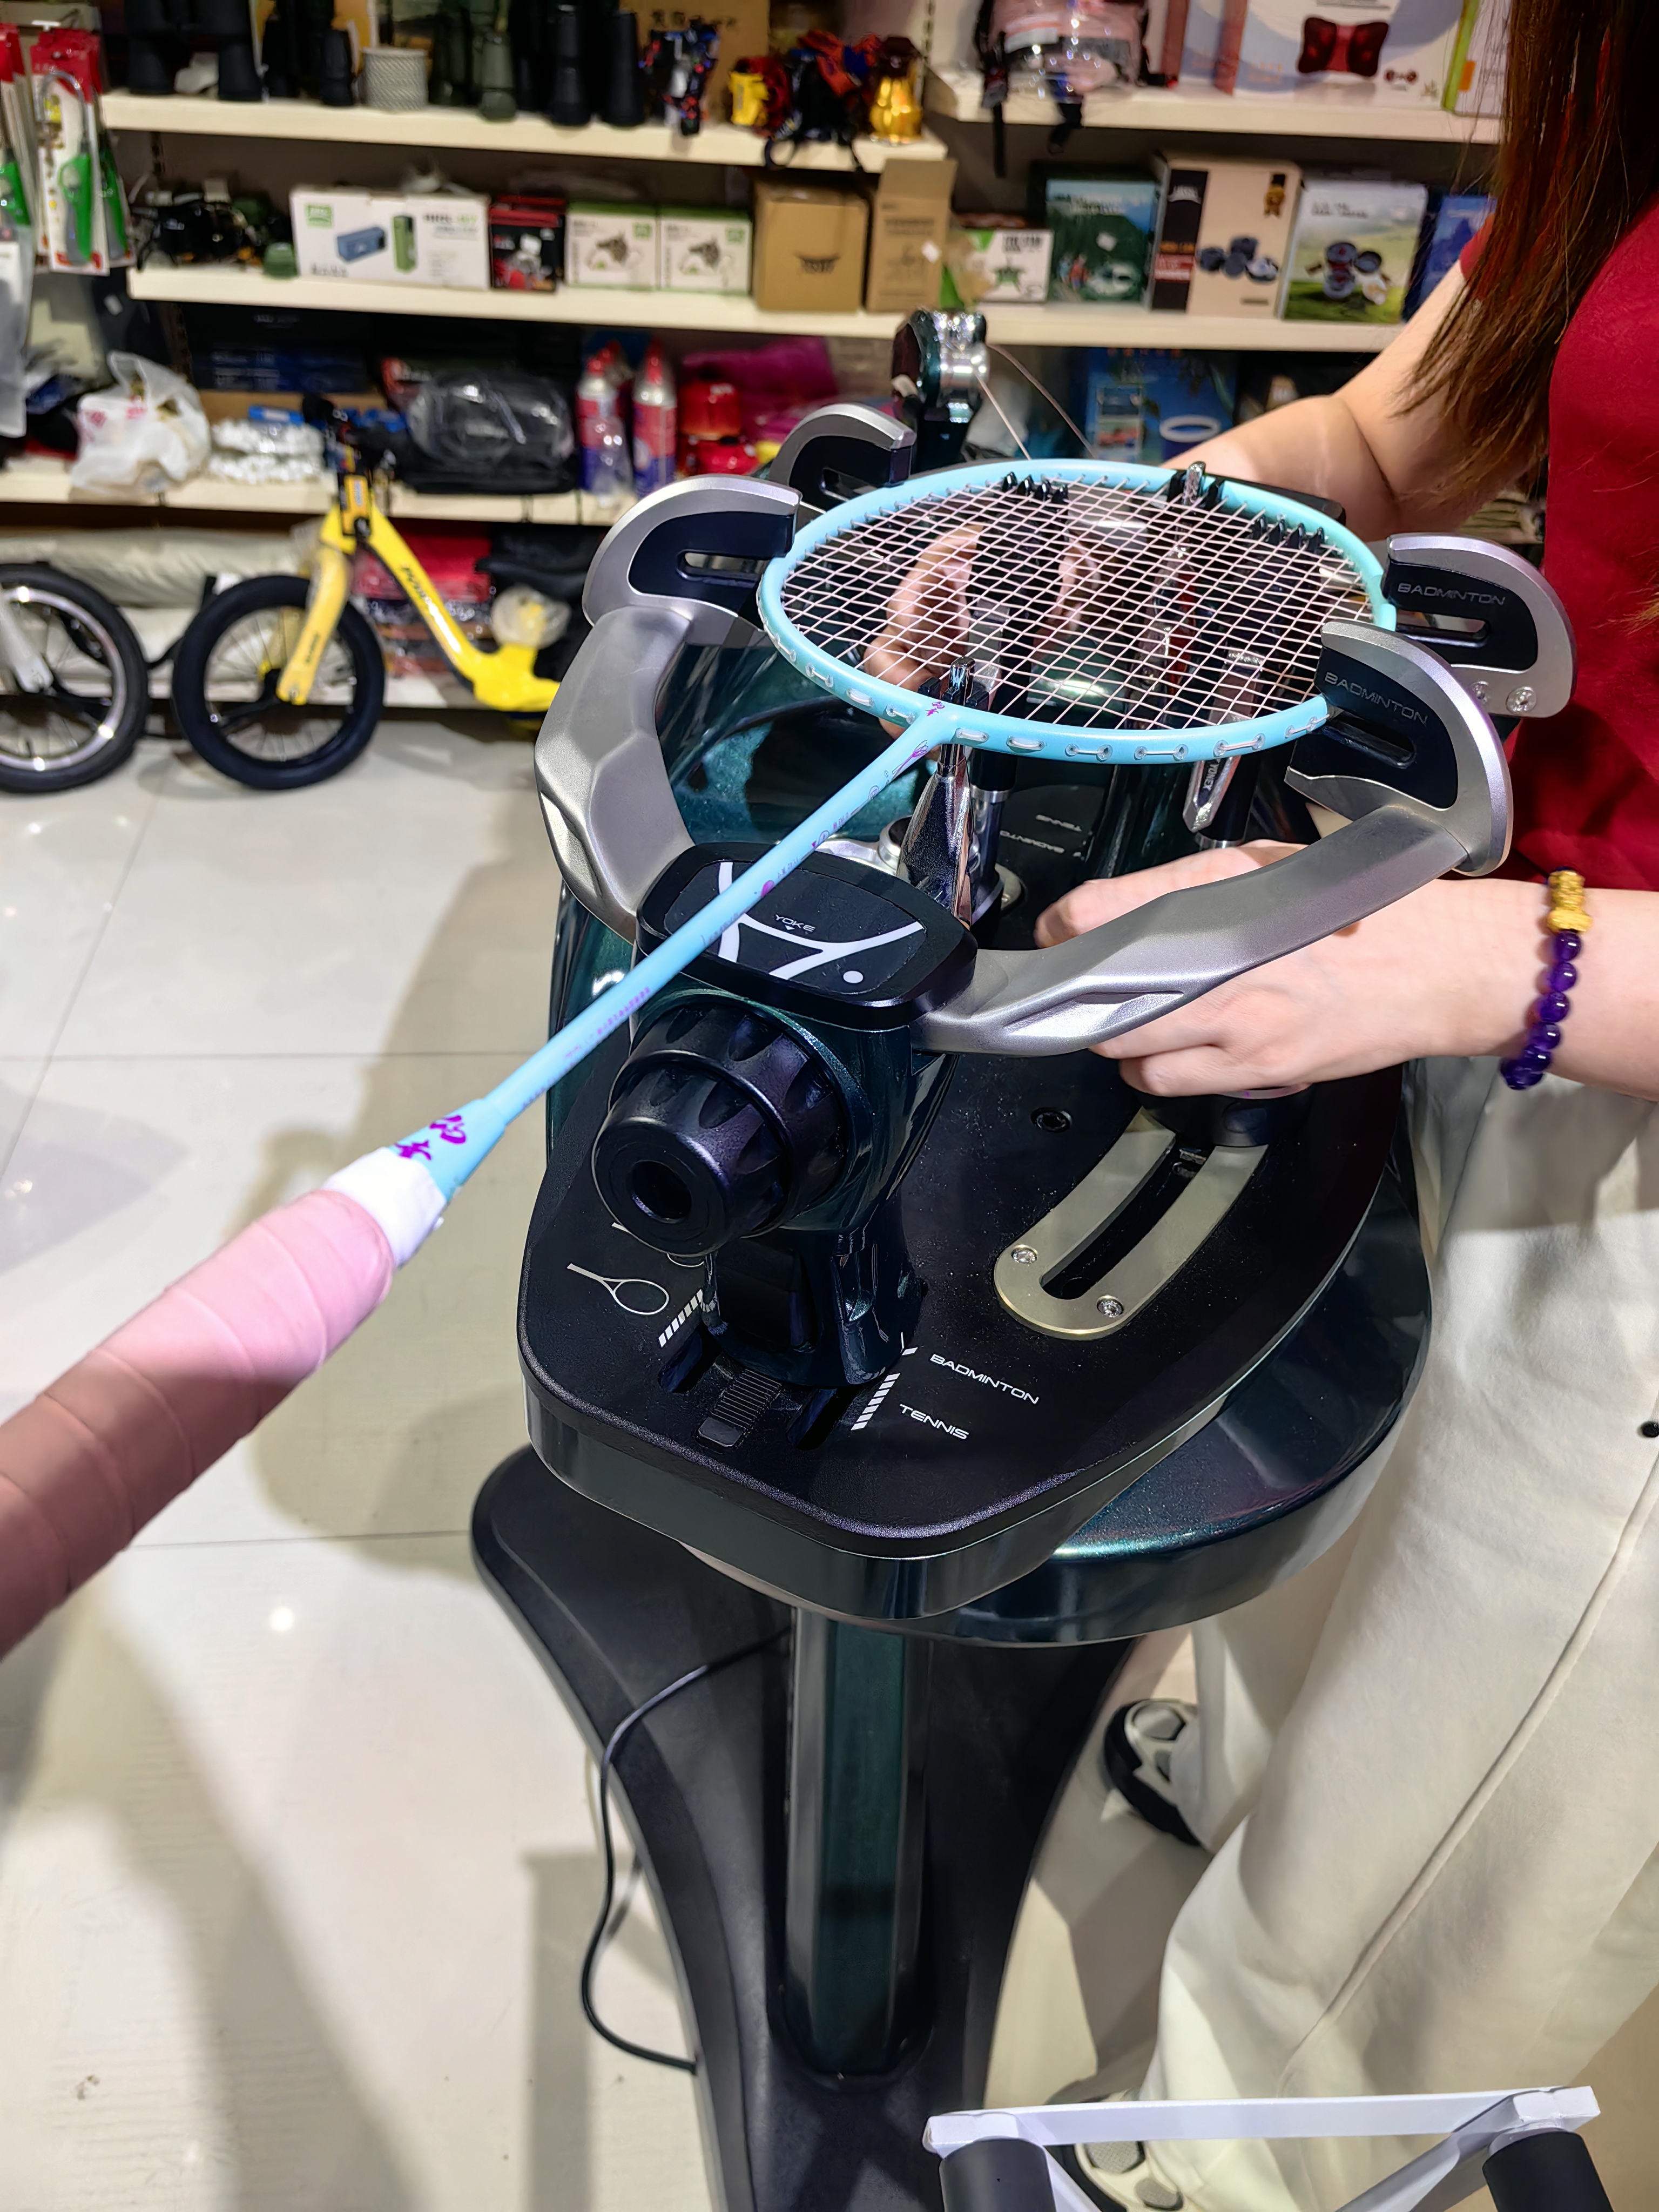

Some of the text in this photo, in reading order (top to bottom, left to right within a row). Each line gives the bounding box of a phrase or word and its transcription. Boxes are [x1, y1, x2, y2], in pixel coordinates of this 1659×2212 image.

[1397, 582, 1506, 605] BADMINTON
[1325, 672, 1428, 726] BADMINTON
[774, 913, 816, 933] YOKE
[929, 1353, 1040, 1405] BADMINTON
[899, 1403, 969, 1440] TENNIS
